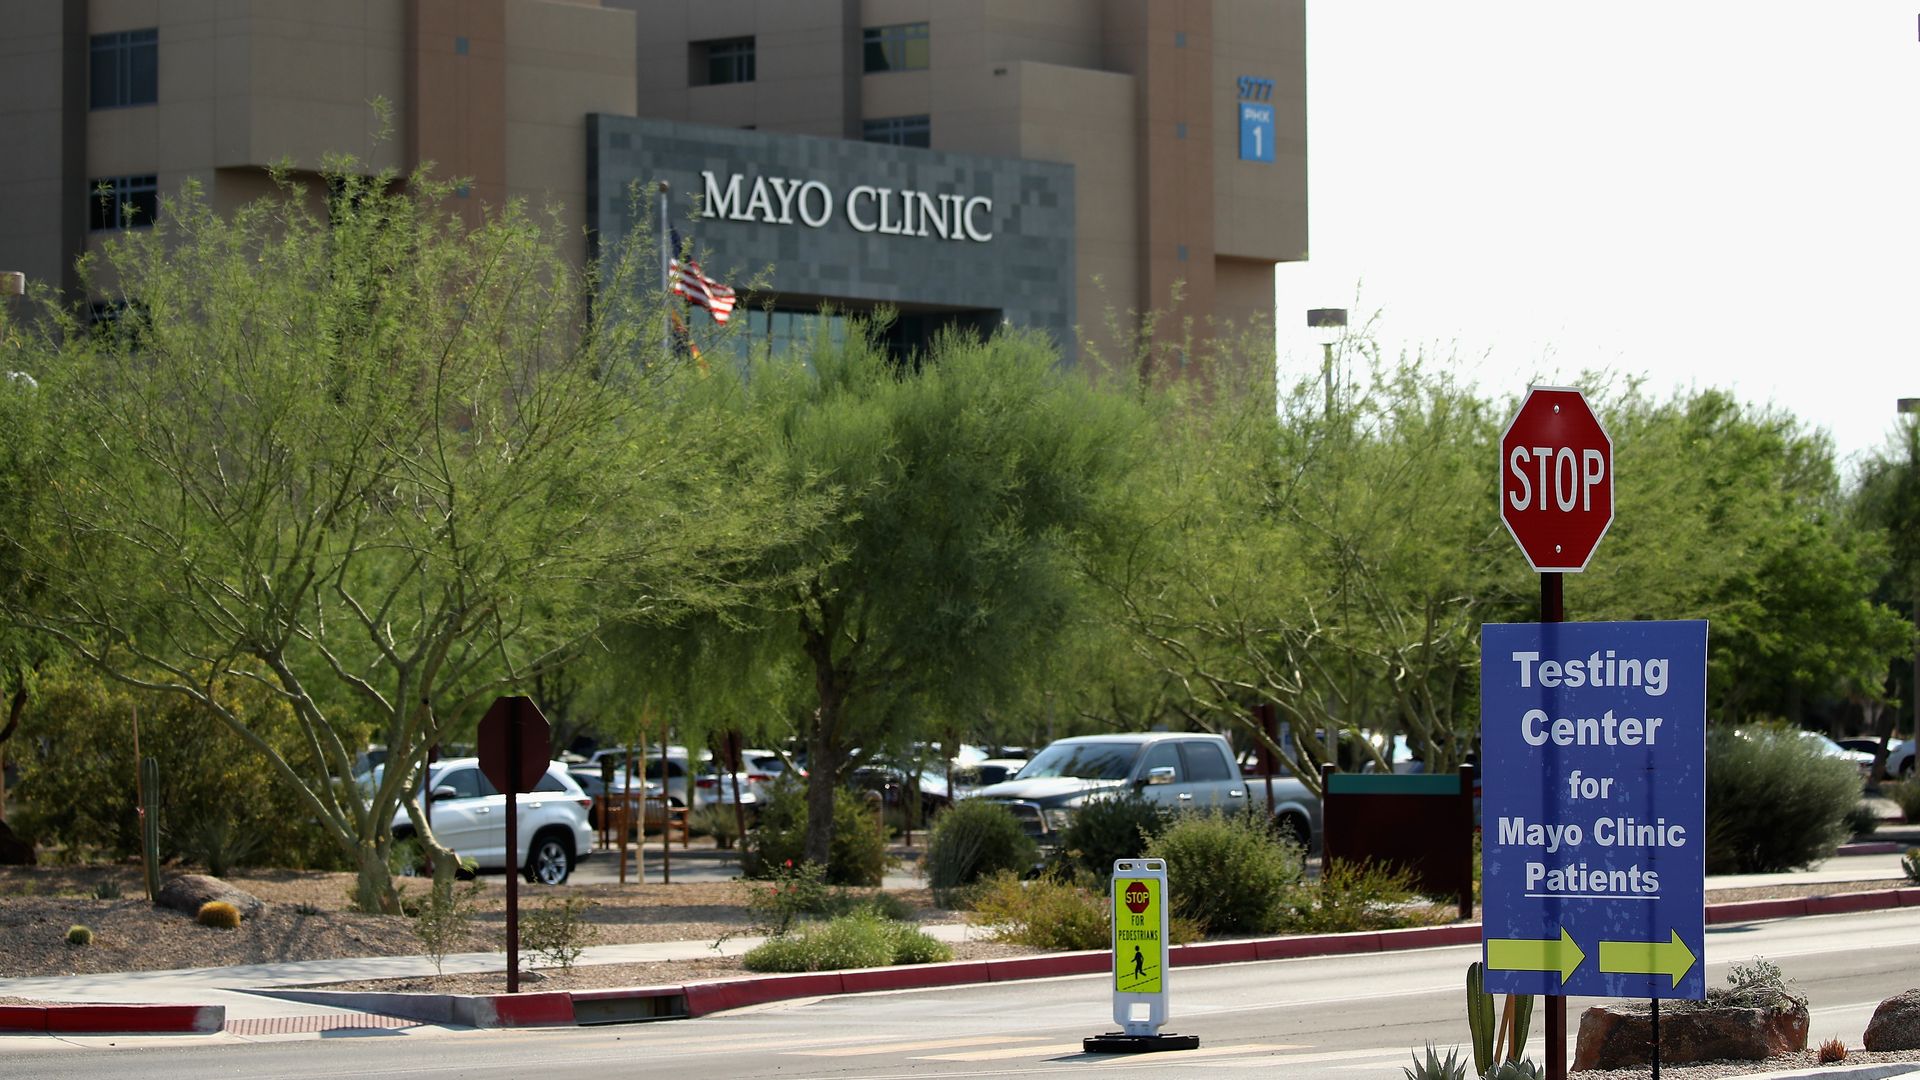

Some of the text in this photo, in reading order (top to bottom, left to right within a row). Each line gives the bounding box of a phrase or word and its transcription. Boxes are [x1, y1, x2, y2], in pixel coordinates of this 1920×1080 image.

[1244, 108, 1271, 122] PHX
[1253, 126, 1263, 158] 1
[701, 171, 993, 243] MAYO CLINIC
[1509, 445, 1605, 513] STOP
[1512, 650, 1669, 696] Testing
[1521, 708, 1663, 746] Center
[1568, 770, 1613, 799] for
[1498, 817, 1686, 853] Mayo Clinic
[1525, 862, 1660, 893] Patients
[1126, 891, 1149, 904] STOP
[1118, 929, 1158, 941] PEDESTRIANS
[1131, 915, 1144, 926] FOR
